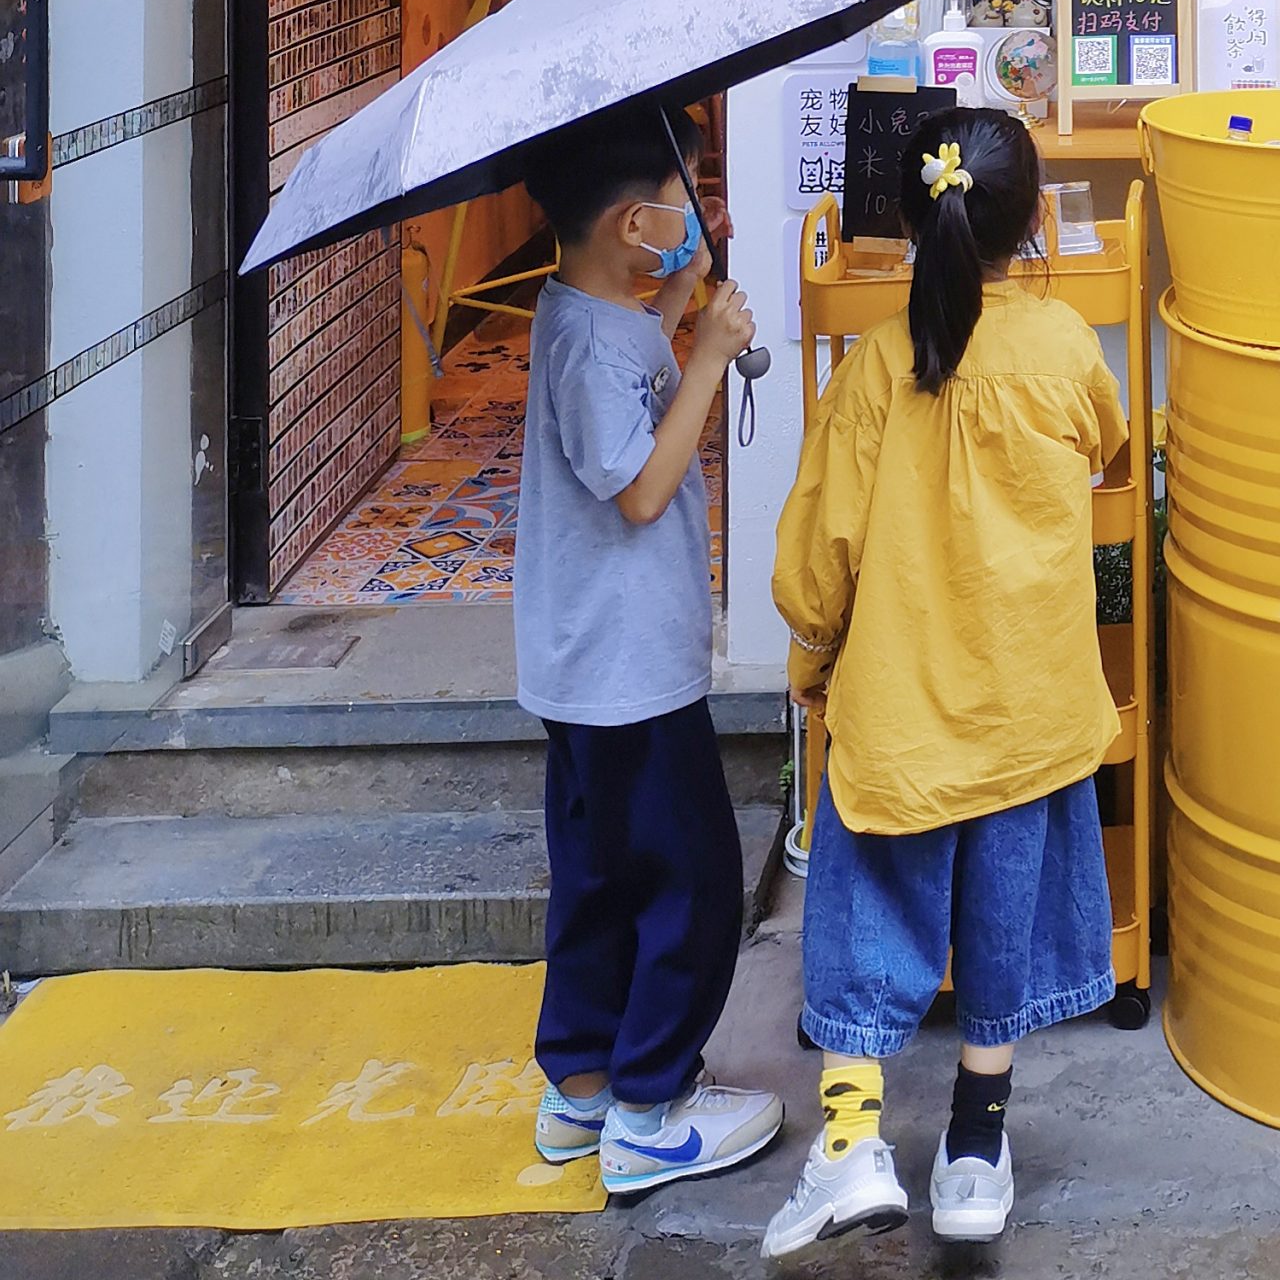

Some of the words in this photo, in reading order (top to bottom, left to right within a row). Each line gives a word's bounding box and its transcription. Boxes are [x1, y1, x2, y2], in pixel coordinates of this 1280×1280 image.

[1078, 11, 1163, 35] 扫码支付
[800, 88, 849, 111] 宠物
[800, 114, 847, 137] 友好
[859, 108, 930, 135] 小兔
